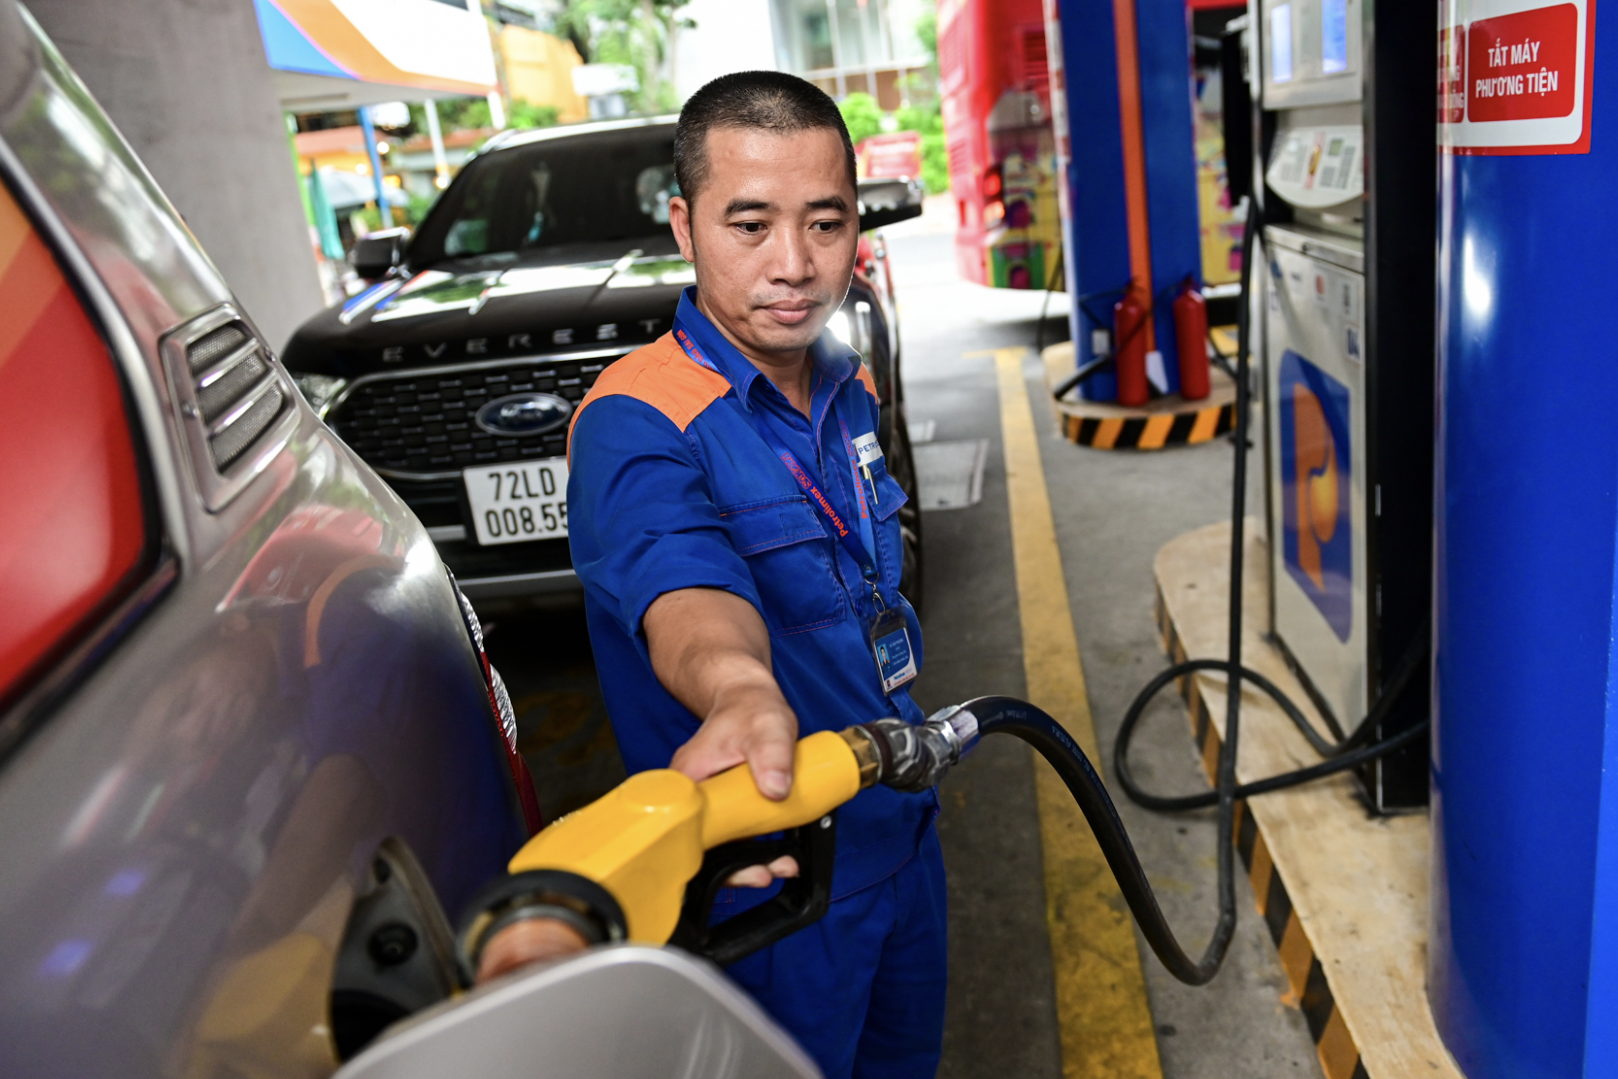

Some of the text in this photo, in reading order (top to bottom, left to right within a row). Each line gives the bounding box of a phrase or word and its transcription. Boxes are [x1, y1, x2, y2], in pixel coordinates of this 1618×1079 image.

[1488, 38, 1540, 67] TẮT MÁY
[1475, 67, 1558, 98] PHƯƠNG TIỆN
[382, 319, 661, 362] EVEREST
[488, 467, 556, 501] 72LD
[852, 459, 868, 519] Petrolimex
[810, 486, 849, 537] Petrolimex
